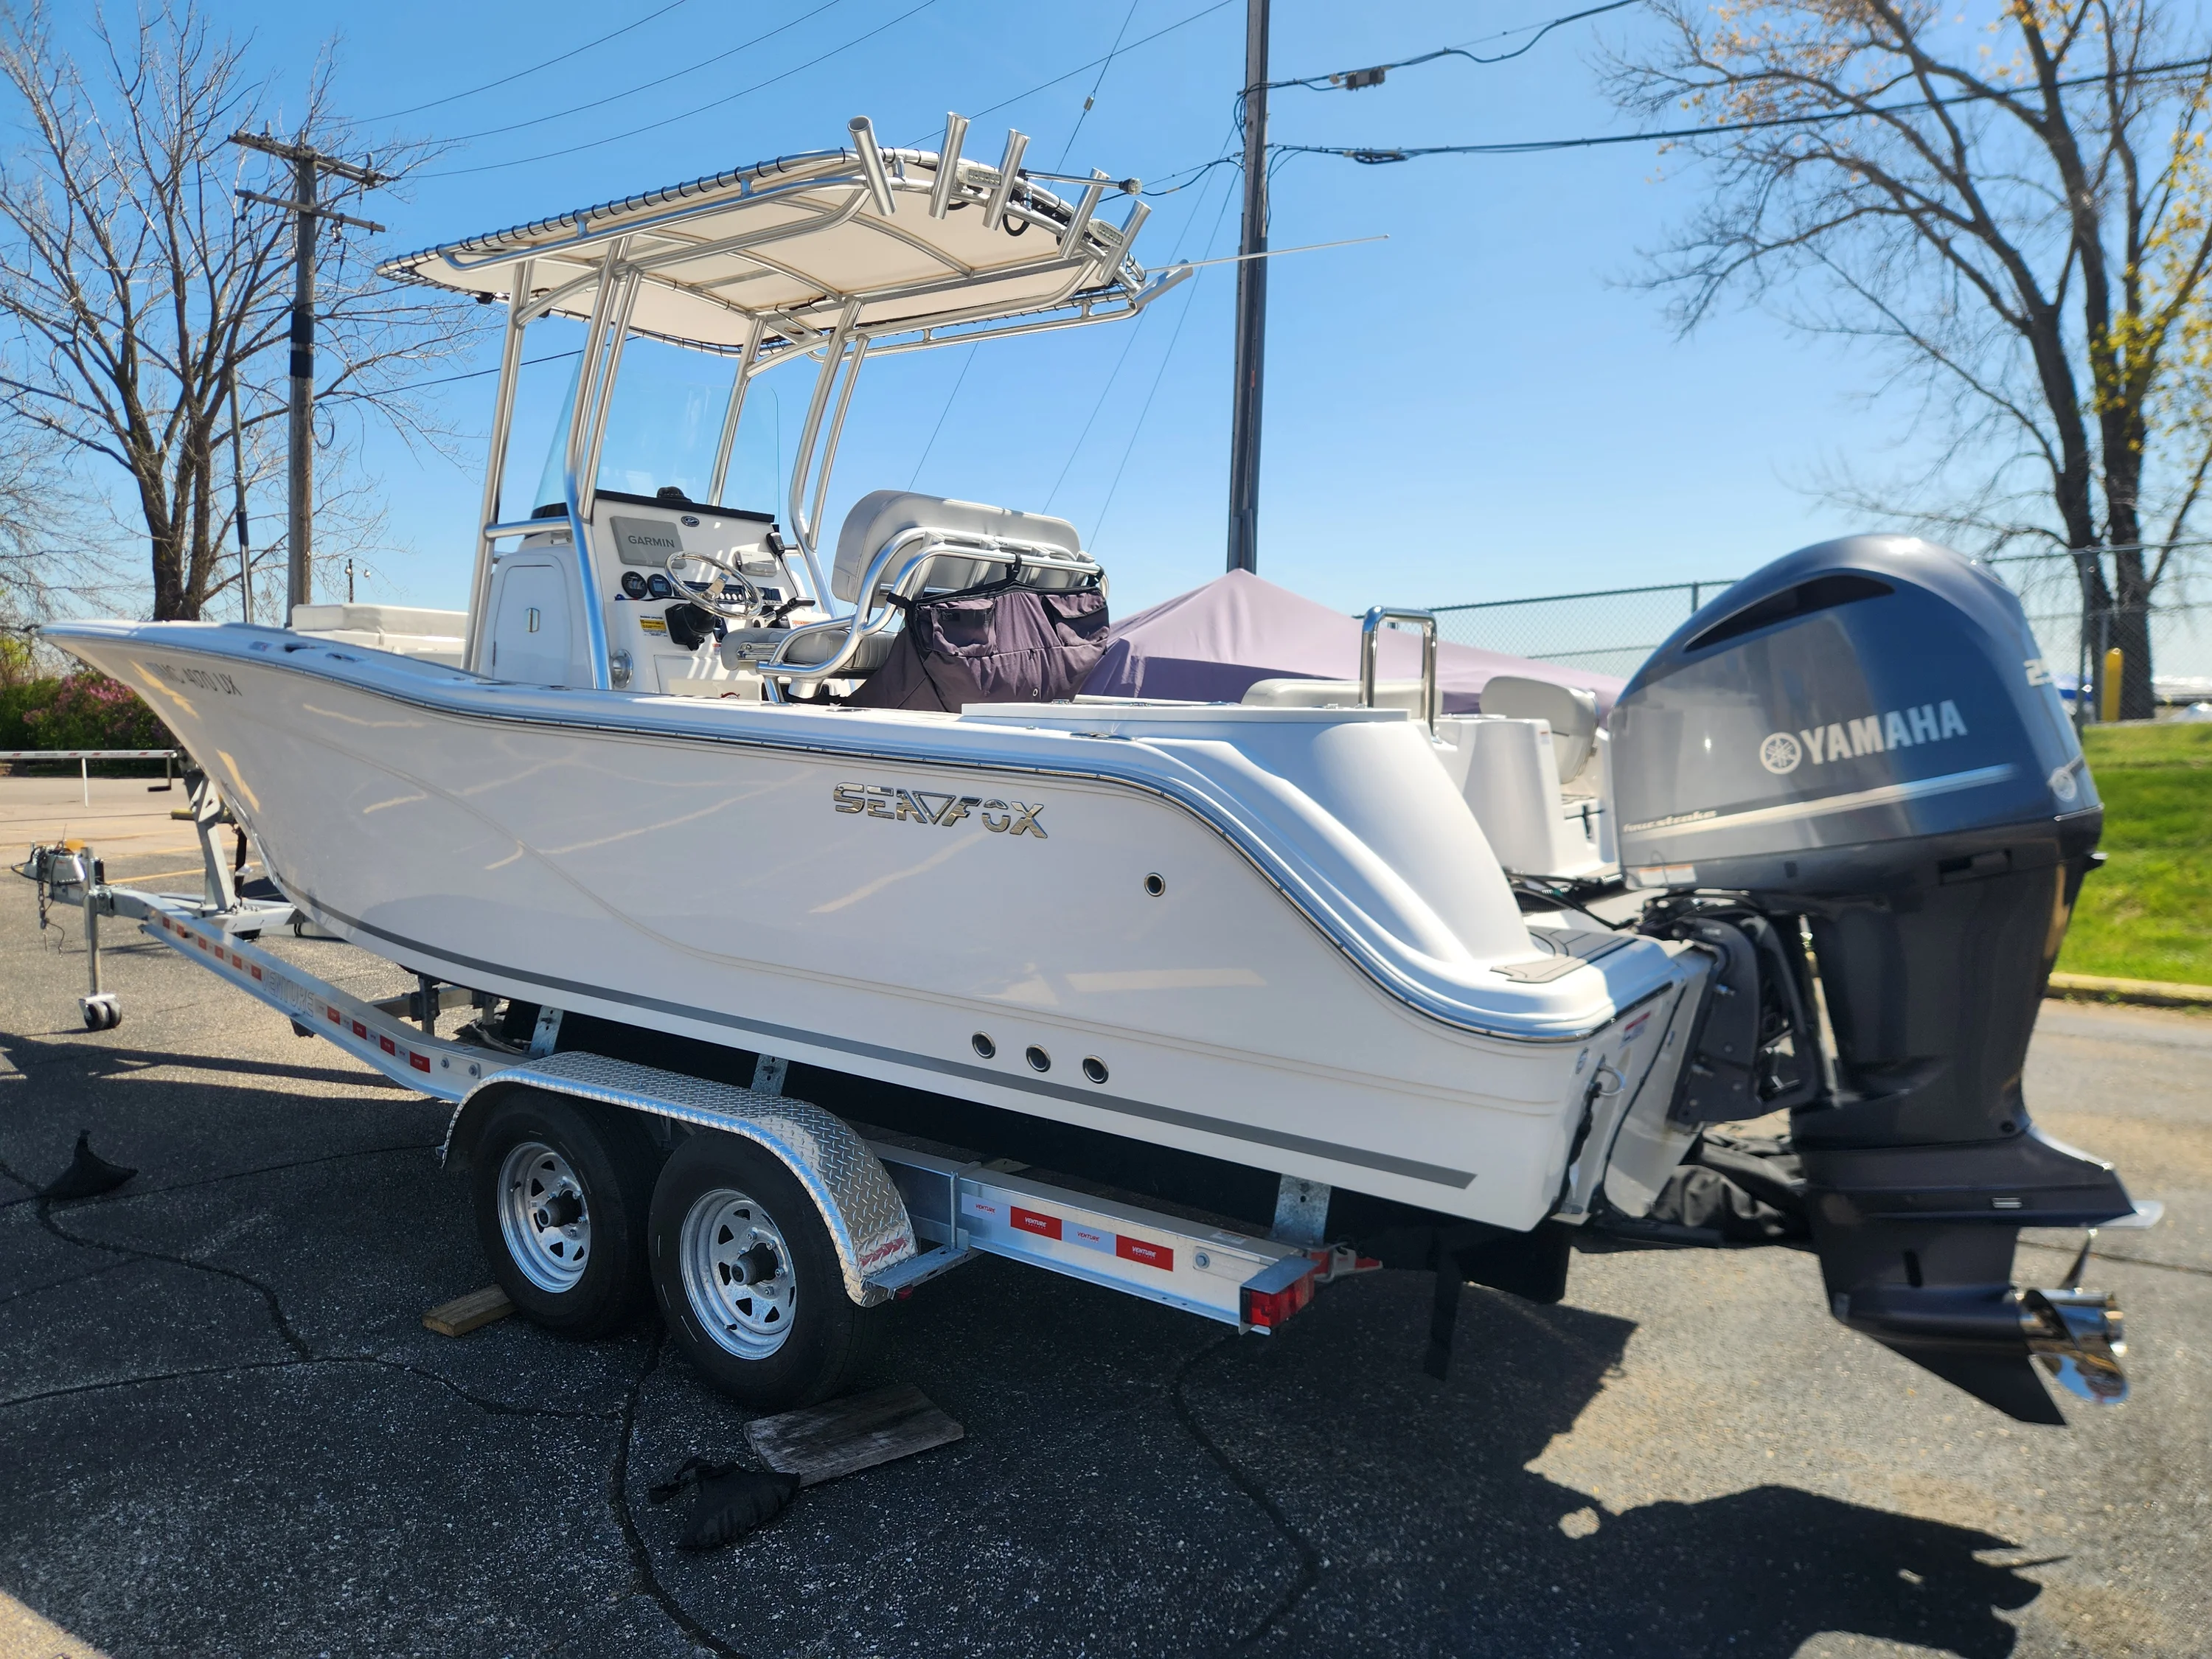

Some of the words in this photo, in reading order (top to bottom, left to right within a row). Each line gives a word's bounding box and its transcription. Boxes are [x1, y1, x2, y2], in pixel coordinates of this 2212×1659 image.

[628, 535, 675, 548] GARMIN
[212, 672, 243, 697] UX
[1800, 700, 1968, 765] YAMAHA
[262, 970, 315, 1018] VENTURE
[975, 1203, 995, 1213] VENTURE
[1025, 1217, 1047, 1228] VENTURE
[1077, 1231, 1100, 1242] VENTURE
[1132, 1246, 1157, 1258] VENTURE
